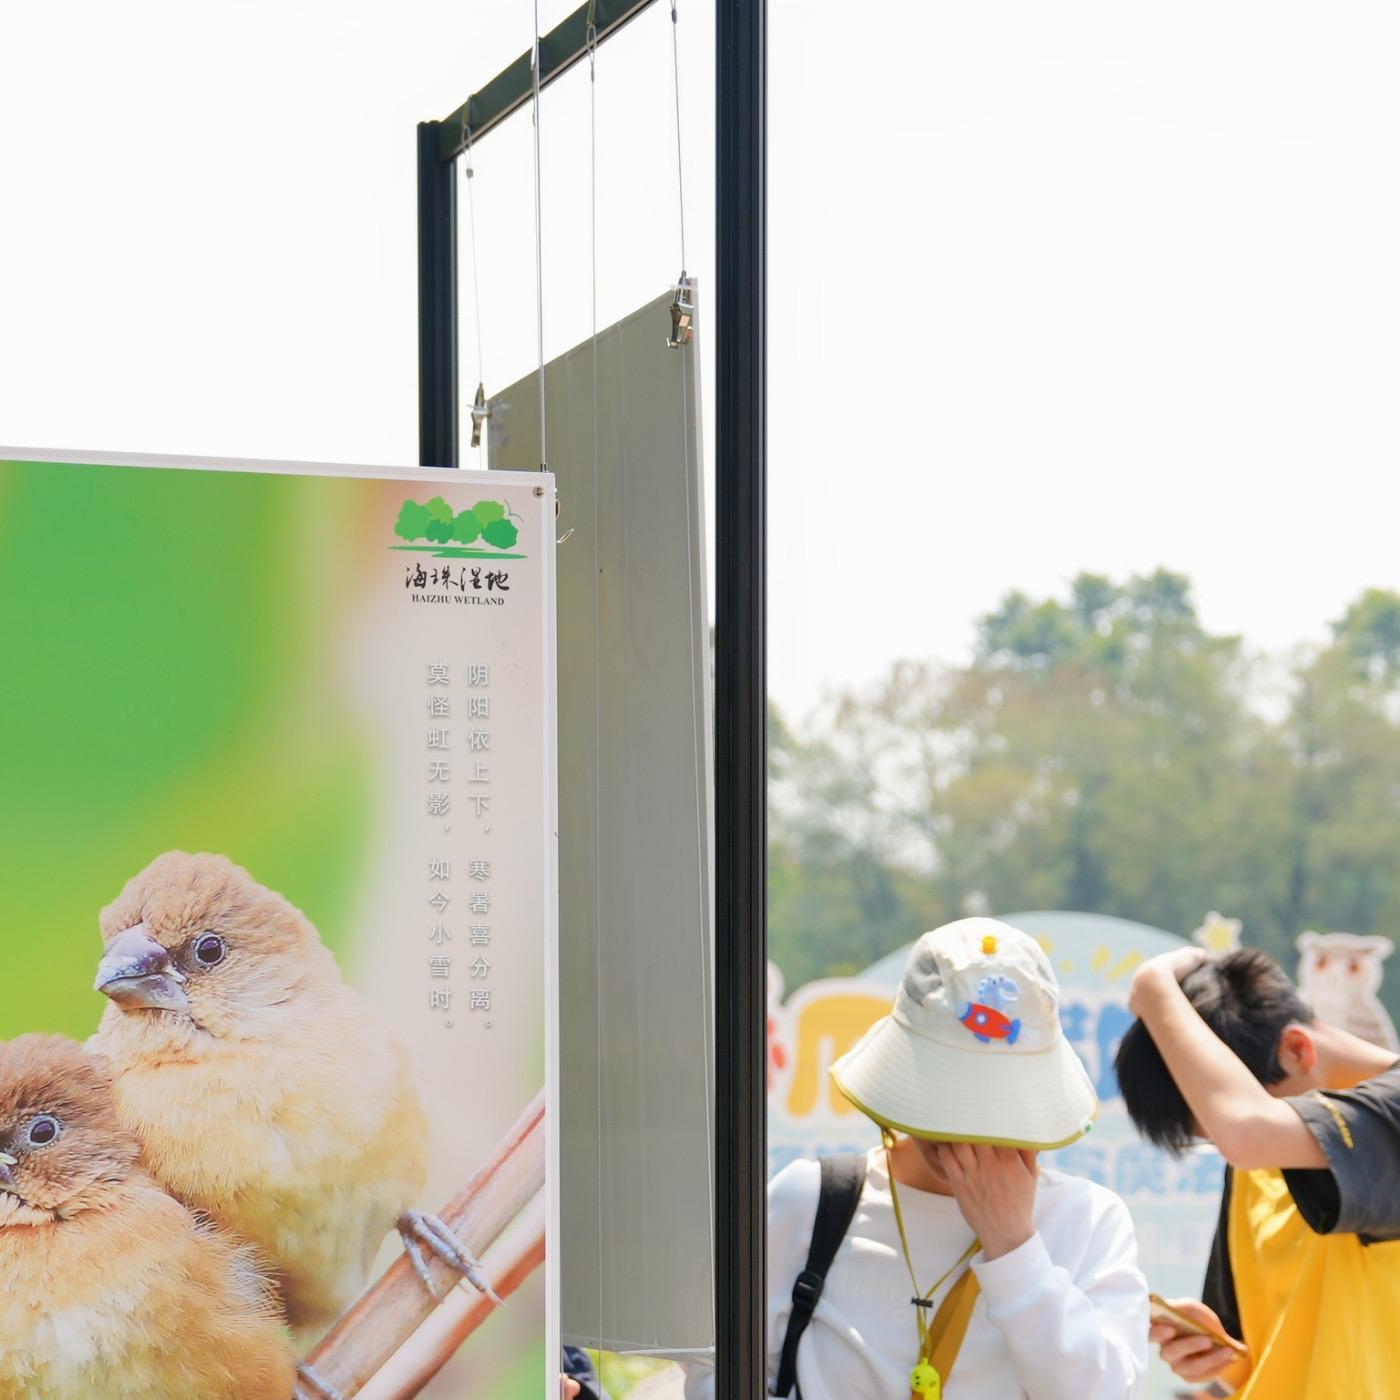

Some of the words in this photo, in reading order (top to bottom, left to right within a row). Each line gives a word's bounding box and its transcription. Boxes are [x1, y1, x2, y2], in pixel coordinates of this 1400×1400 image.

[405, 562, 510, 592] 海珠湿地
[412, 594, 451, 604] HAIZHU
[454, 595, 505, 606] WETLAND
